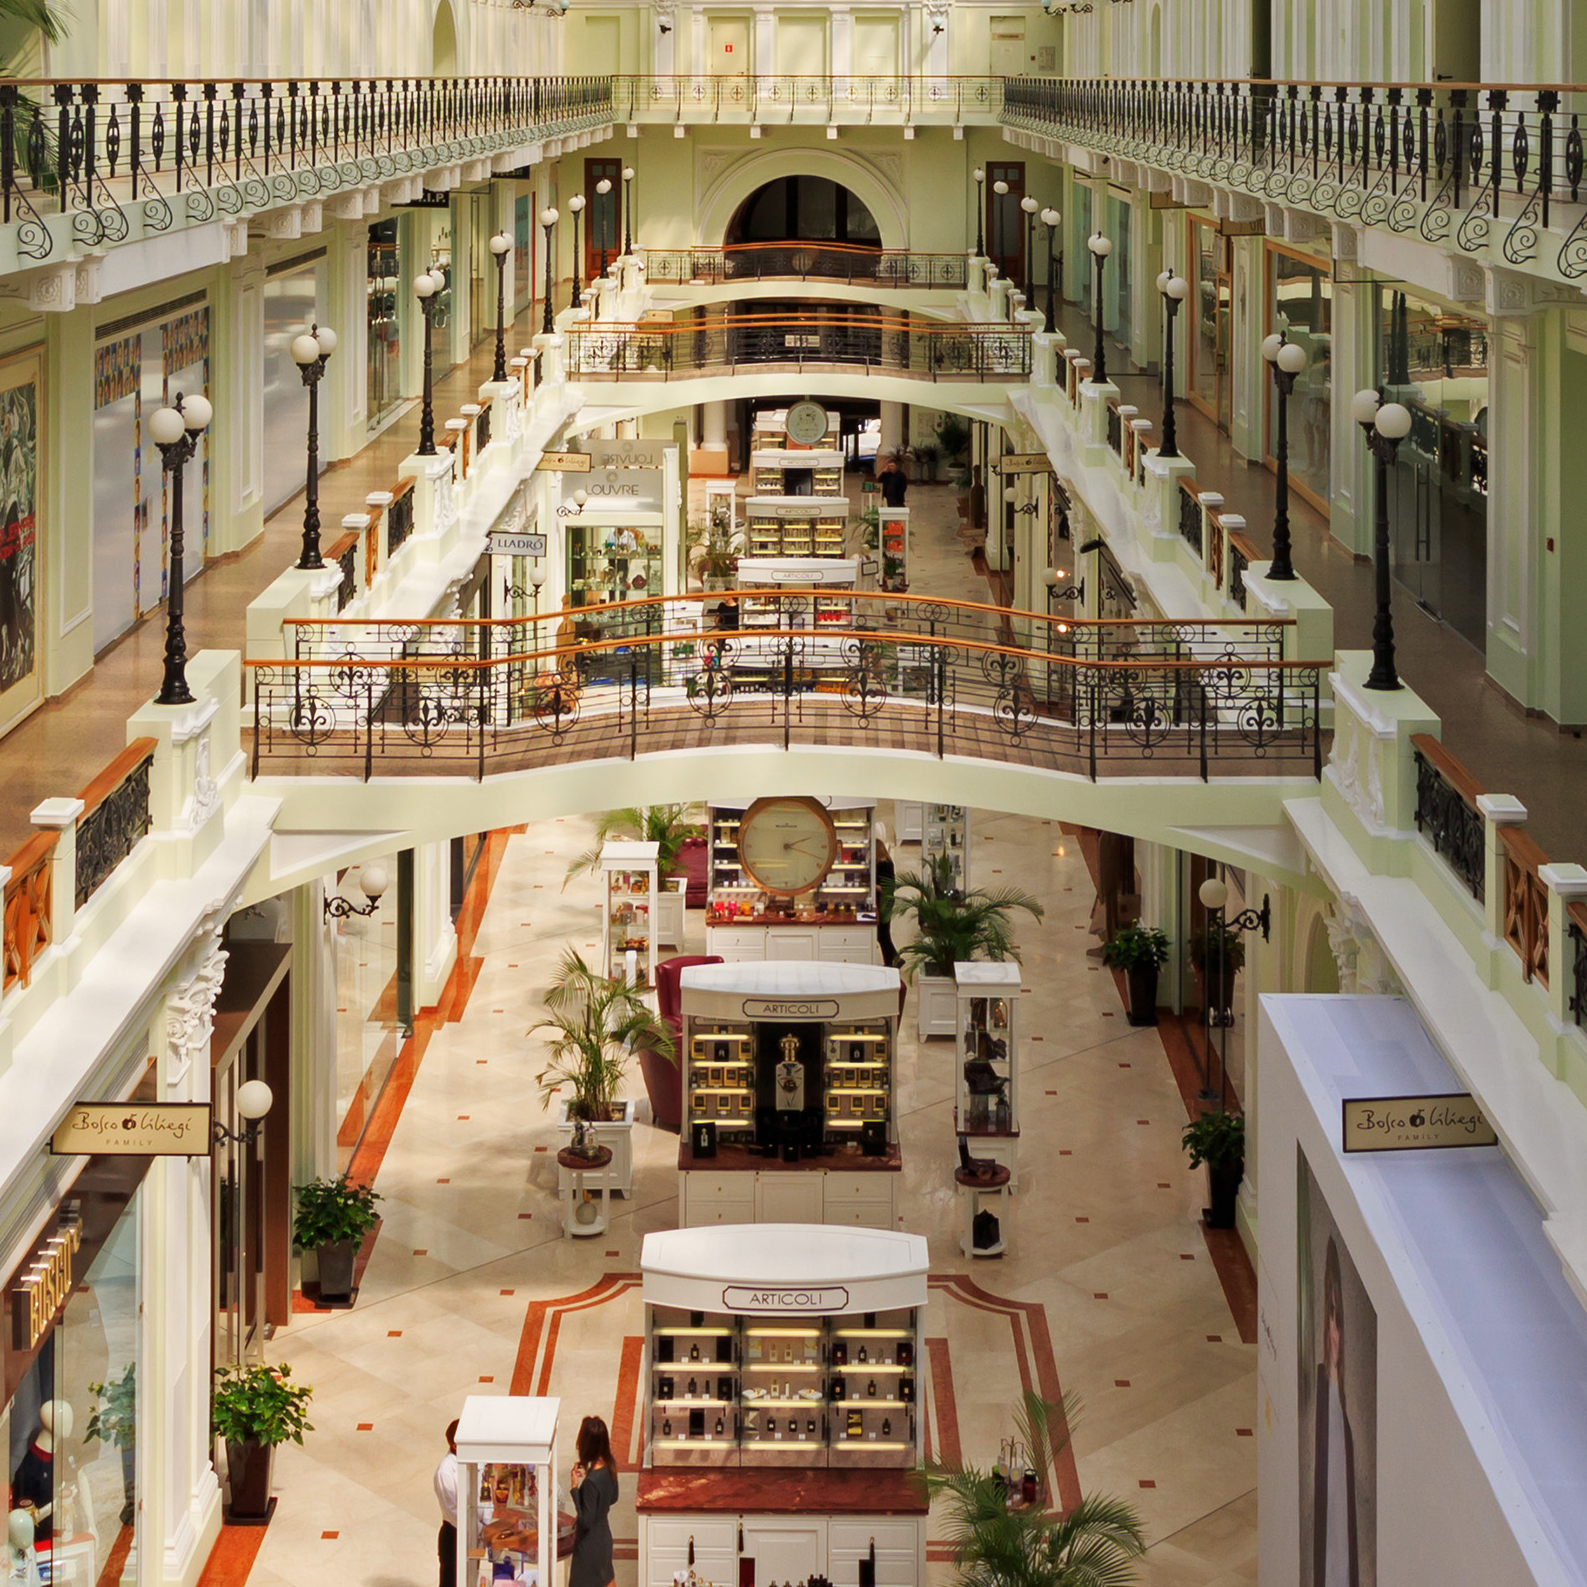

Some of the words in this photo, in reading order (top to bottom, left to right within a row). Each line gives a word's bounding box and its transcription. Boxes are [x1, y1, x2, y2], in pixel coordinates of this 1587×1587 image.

[585, 484, 639, 496] LOUVRE
[498, 538, 544, 552] LLADRÓ
[763, 1004, 819, 1014] ARTICOLI
[72, 1111, 118, 1135] Bosco
[1356, 1109, 1406, 1134] Bosco
[749, 1292, 823, 1306] ARTICOLI
